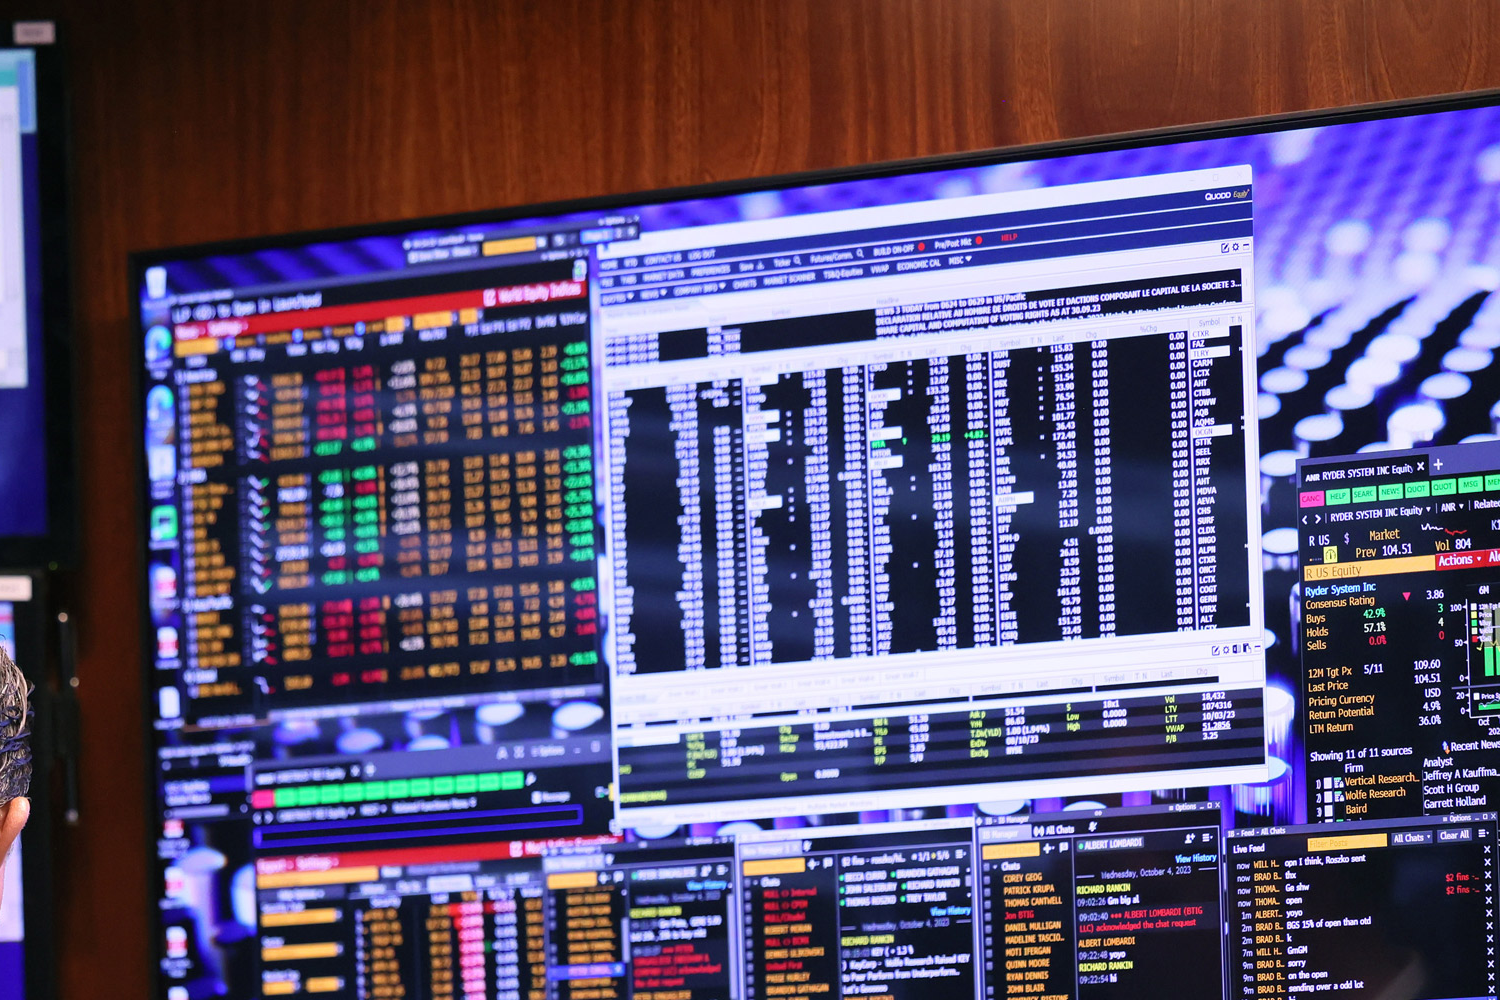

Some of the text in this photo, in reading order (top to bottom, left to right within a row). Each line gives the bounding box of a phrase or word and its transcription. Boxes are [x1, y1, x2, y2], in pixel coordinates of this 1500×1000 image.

[1002, 233, 1018, 241] HELP
[1101, 290, 1141, 301] COMPOSANT
[1142, 289, 1150, 297] LE
[1151, 286, 1179, 296] CAPITAL
[1181, 285, 1189, 293] DE
[1202, 280, 1229, 291] SOCIETE
[1071, 304, 1101, 314] 30.09.23
[1192, 340, 1205, 348] FAZ
[1193, 369, 1210, 377] LCTX
[1331, 503, 1456, 522] RYDER SYSTEM INC Equity ANR
[1198, 526, 1215, 534] CLDX
[1309, 536, 1315, 546] R
[1319, 535, 1330, 545] US
[1369, 529, 1400, 541] Market
[1356, 538, 1471, 558] Prev 104.51 Vol 804
[1439, 554, 1473, 566] Actions
[1306, 564, 1361, 579] R US Equity
[1305, 582, 1376, 597] Ryder System Inc
[1306, 590, 1444, 609] Consensus Rating 3.86
[1306, 608, 1386, 625] Buys 42.9%
[1307, 622, 1386, 637] Holds 57.1%
[1307, 641, 1327, 651] Sells
[1308, 659, 1441, 679] 12M Tgt Px 5/11 109.60
[1308, 673, 1441, 692] Last Price 104.51
[1164, 692, 1226, 703] Vol 18,432
[1309, 688, 1441, 707] Pricing Currency USD
[1202, 701, 1232, 710] 1074316
[1202, 710, 1235, 720] 10/03/23
[1309, 706, 1374, 720] Return Potential
[1310, 715, 1441, 734] LTM Return 36.0%
[1202, 732, 1218, 740] 3.25
[1310, 747, 1413, 762] Showing 11 of 11 sources
[1345, 757, 1453, 773] Firm Analyst
[1345, 775, 1376, 786] Vertical
[1345, 783, 1479, 800] Wolfe Research Scott H Group
[1346, 796, 1486, 814] Baird Garrett Holland
[1233, 830, 1469, 853] Live Feed All Chats Clear All
[1193, 853, 1217, 862] History
[1456, 873, 1469, 881] fins
[1124, 910, 1147, 919] ALBERT
[1149, 908, 1181, 917] LOMBARDI
[1078, 937, 1135, 948] ALBERT LOMBARDI
[1288, 960, 1306, 968] sorry
